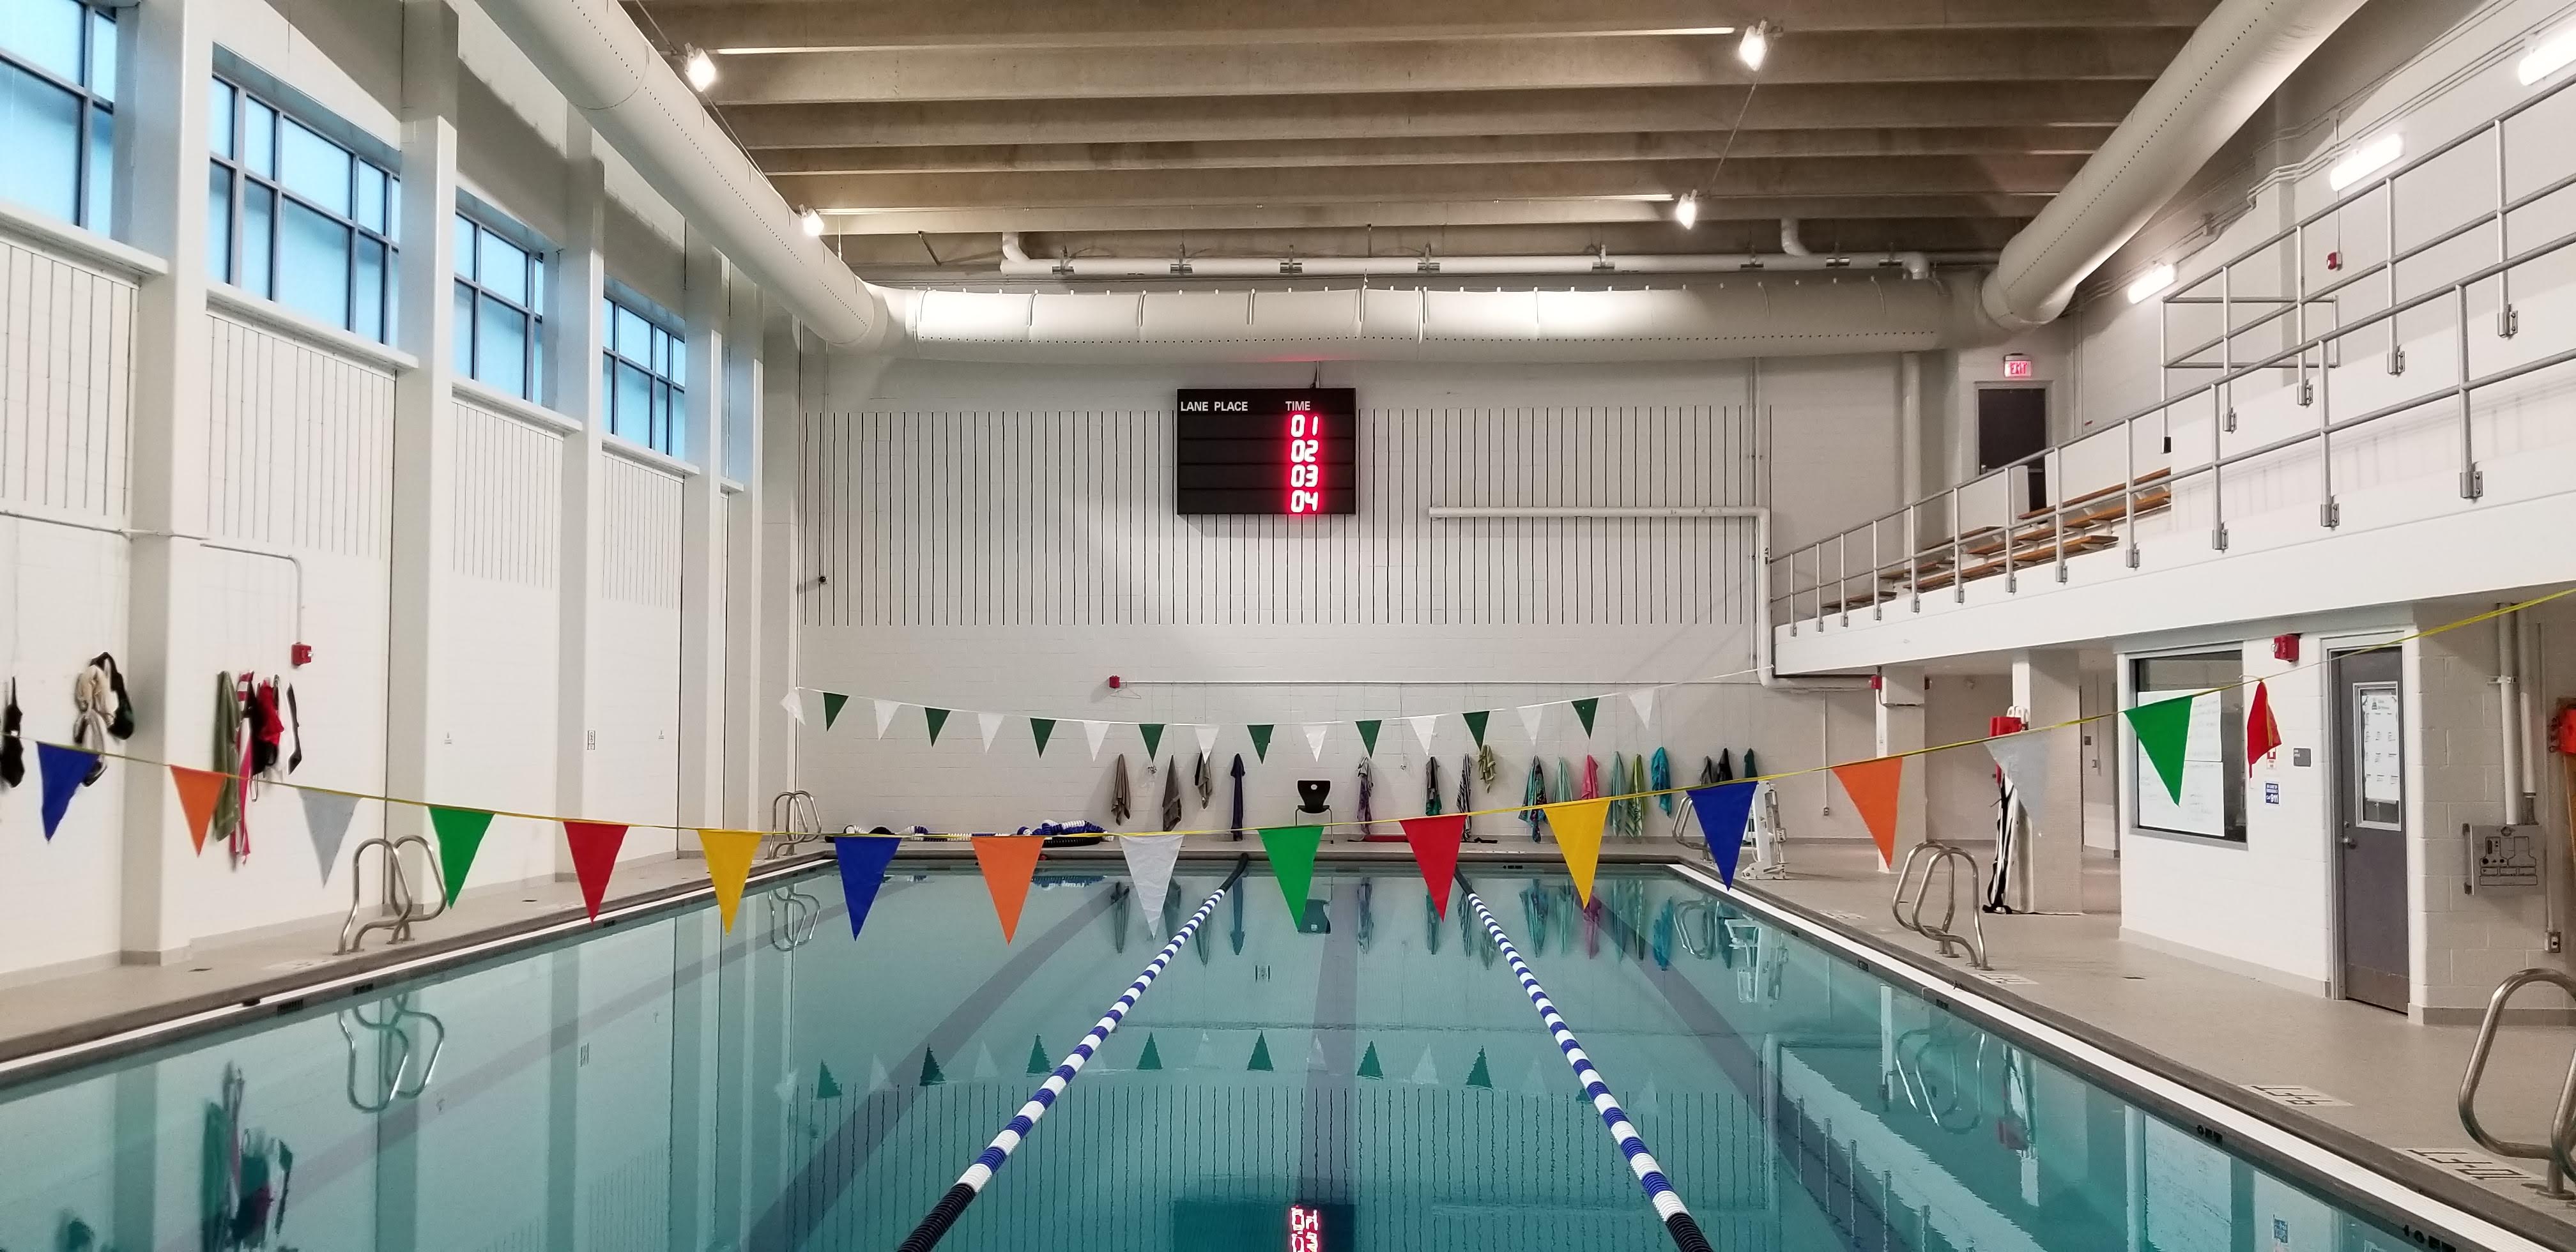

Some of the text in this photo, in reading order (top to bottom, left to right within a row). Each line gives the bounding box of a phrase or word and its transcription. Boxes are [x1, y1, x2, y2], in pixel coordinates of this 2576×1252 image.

[2010, 362, 2028, 375] EXIT
[1180, 401, 1311, 412] LANE PLACE TIME
[1291, 414, 1319, 438] 01
[1291, 439, 1319, 463] 02
[1291, 464, 1319, 487] 03
[1291, 489, 1319, 513] 04
